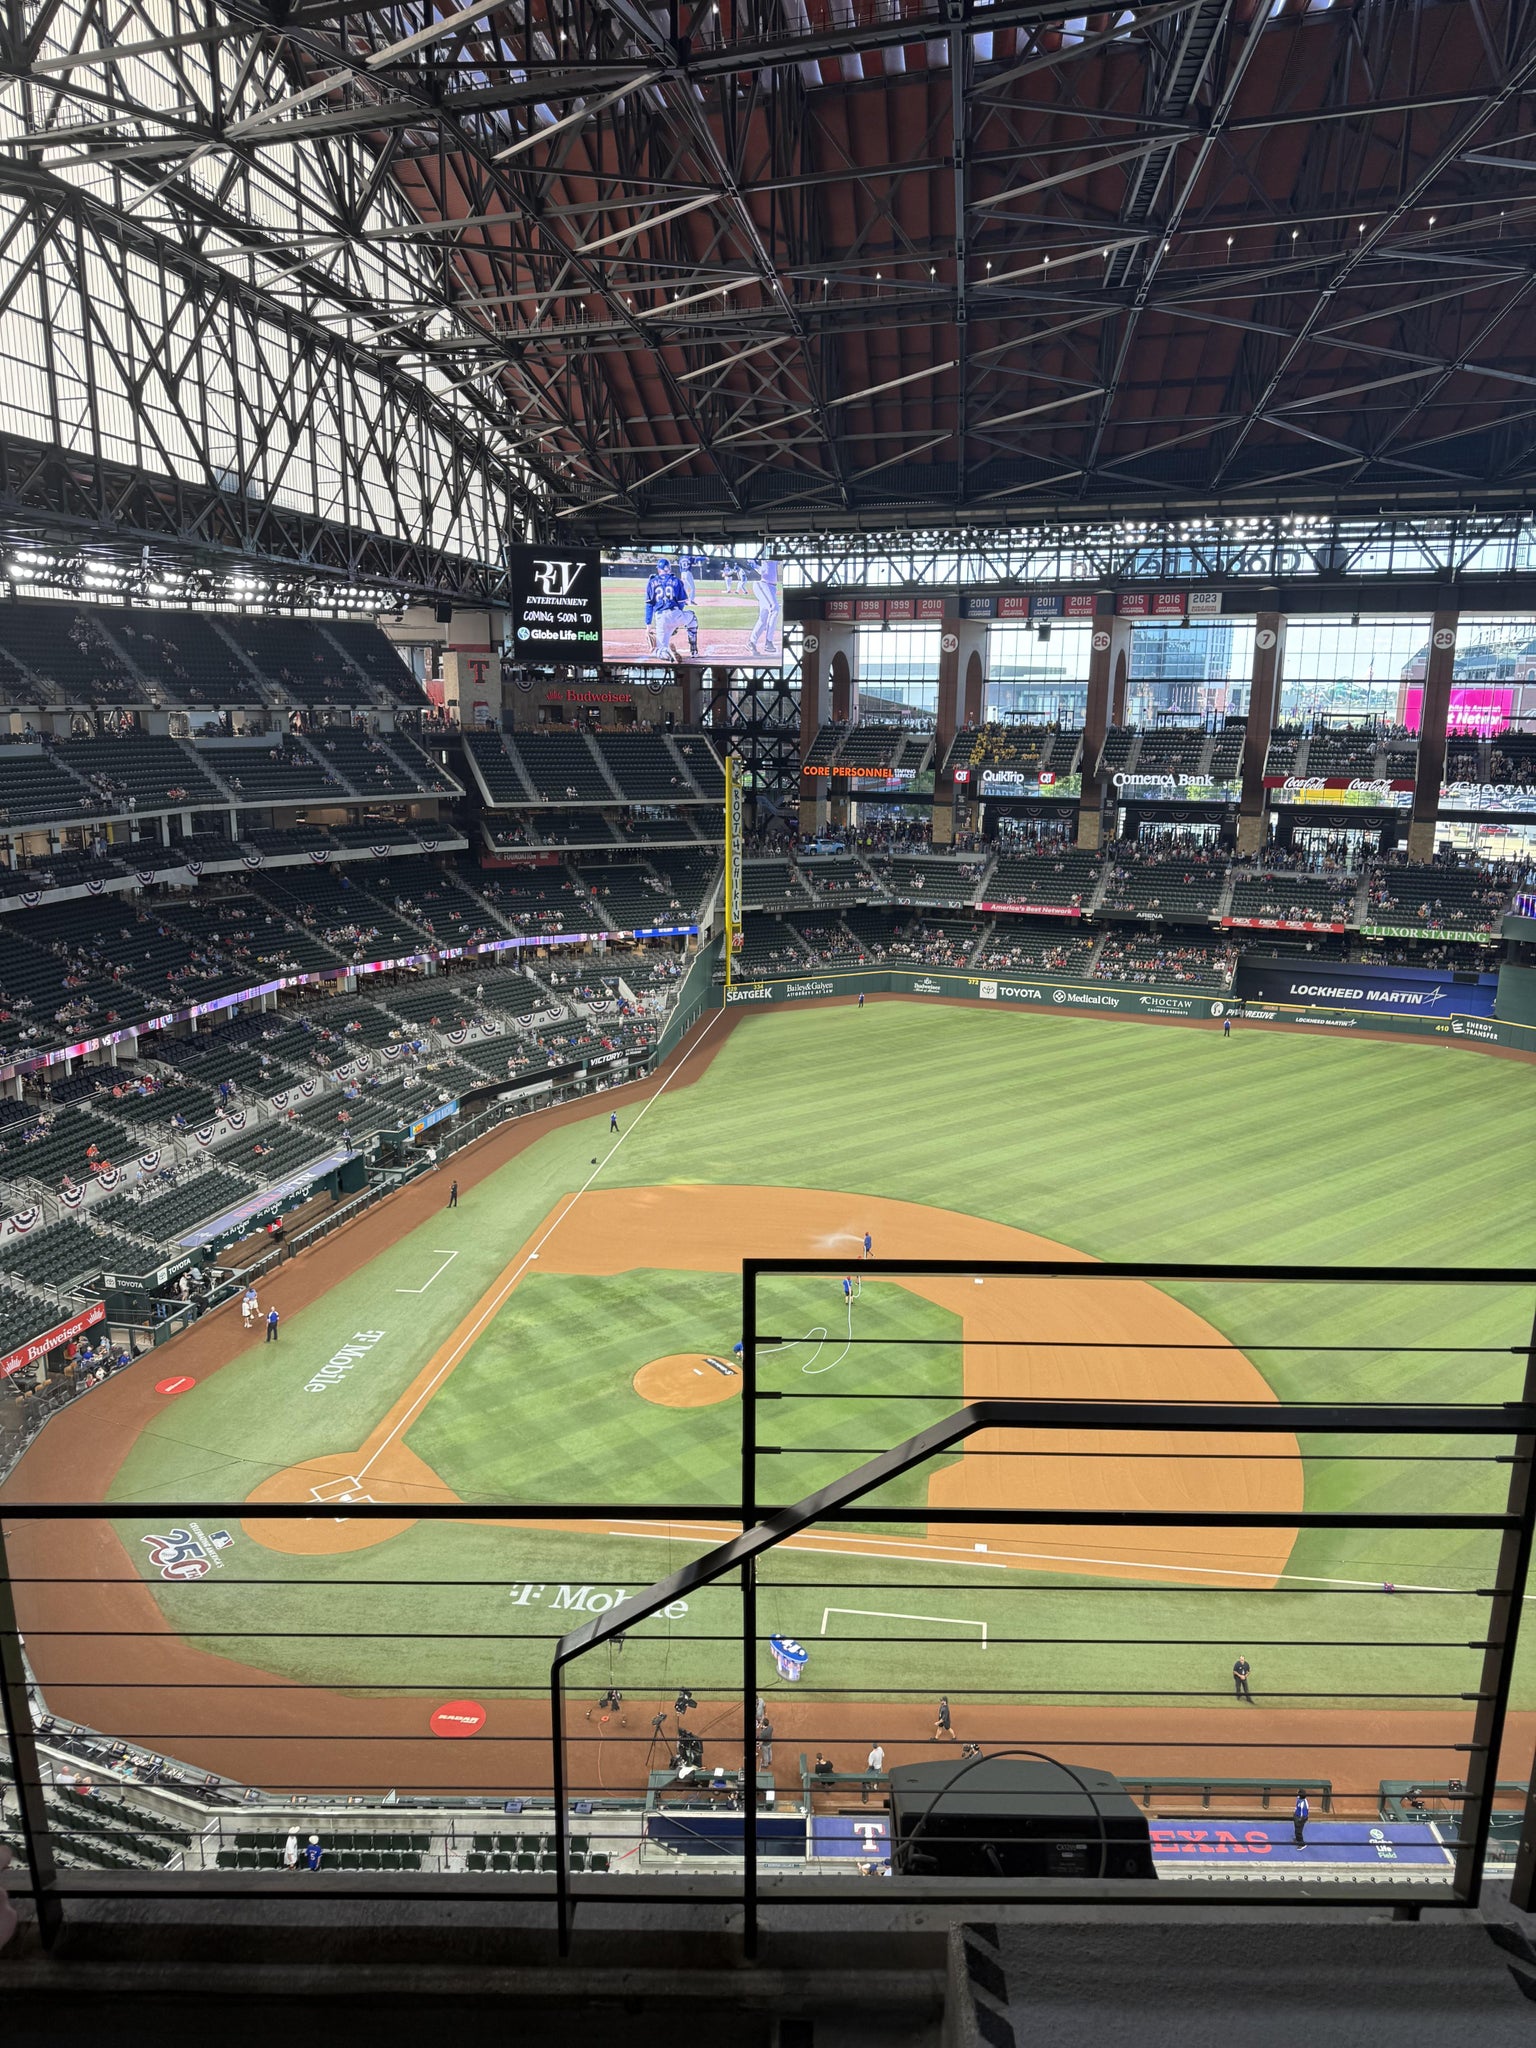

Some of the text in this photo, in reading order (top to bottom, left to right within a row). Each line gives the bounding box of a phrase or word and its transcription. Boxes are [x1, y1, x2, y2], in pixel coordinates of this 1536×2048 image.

[533, 560, 586, 595] REV
[655, 585, 674, 602] 29
[1159, 594, 1180, 604] 2016
[1193, 594, 1217, 603] 2023
[526, 596, 588, 606] ENTERTAINMENT
[830, 601, 848, 611] 1996
[861, 601, 880, 610] 1998
[891, 600, 910, 609] 1999
[922, 600, 941, 609] 2010
[970, 598, 990, 608] 2010
[1004, 598, 1023, 607] 2011
[1037, 597, 1055, 607] 2011
[1071, 596, 1092, 606] 2012
[1123, 595, 1144, 605] 2015
[523, 610, 592, 623] COMING SOON TO
[531, 630, 598, 641] Globe Life Field
[1094, 635, 1107, 647] 26
[1436, 633, 1453, 645] 29
[804, 638, 816, 649] 42
[943, 638, 956, 648] 34
[469, 660, 490, 684] T
[566, 690, 631, 703] Budweiser
[803, 766, 830, 776] CORE
[832, 767, 893, 778] PERSONNEL
[955, 771, 968, 781] QT
[983, 770, 1025, 784] QuikTrip
[1040, 773, 1052, 783] QT
[1178, 774, 1214, 786] Bank
[1283, 776, 1329, 791] Coca-Cola
[1348, 778, 1394, 793] Coca-Cola
[1457, 782, 1536, 796] CHOCTAW
[732, 788, 741, 921] ROOT 4 CHIKIN
[991, 904, 1025, 912] America's
[1373, 927, 1487, 942] LUXOR STAFFING
[726, 987, 772, 1002] SEATGEEK
[1000, 987, 1042, 999] TOYOTA
[1290, 984, 1423, 1005] LOCKHEED MARTIN
[1067, 993, 1119, 1007] Medical City
[1144, 996, 1192, 1008] CHOCTAW
[1295, 1017, 1325, 1025] LOCKHEED
[1466, 1022, 1493, 1031] ENERGY
[1466, 1029, 1498, 1040] TRANSFER
[590, 1051, 621, 1066] VICTORY
[168, 1257, 191, 1275] TOYOTA
[117, 1279, 143, 1289] TOYOTA
[27, 1321, 84, 1360] Budweiser
[304, 1342, 378, 1393] Mobile
[853, 1822, 885, 1852] T
[1150, 1830, 1272, 1854] EXAS
